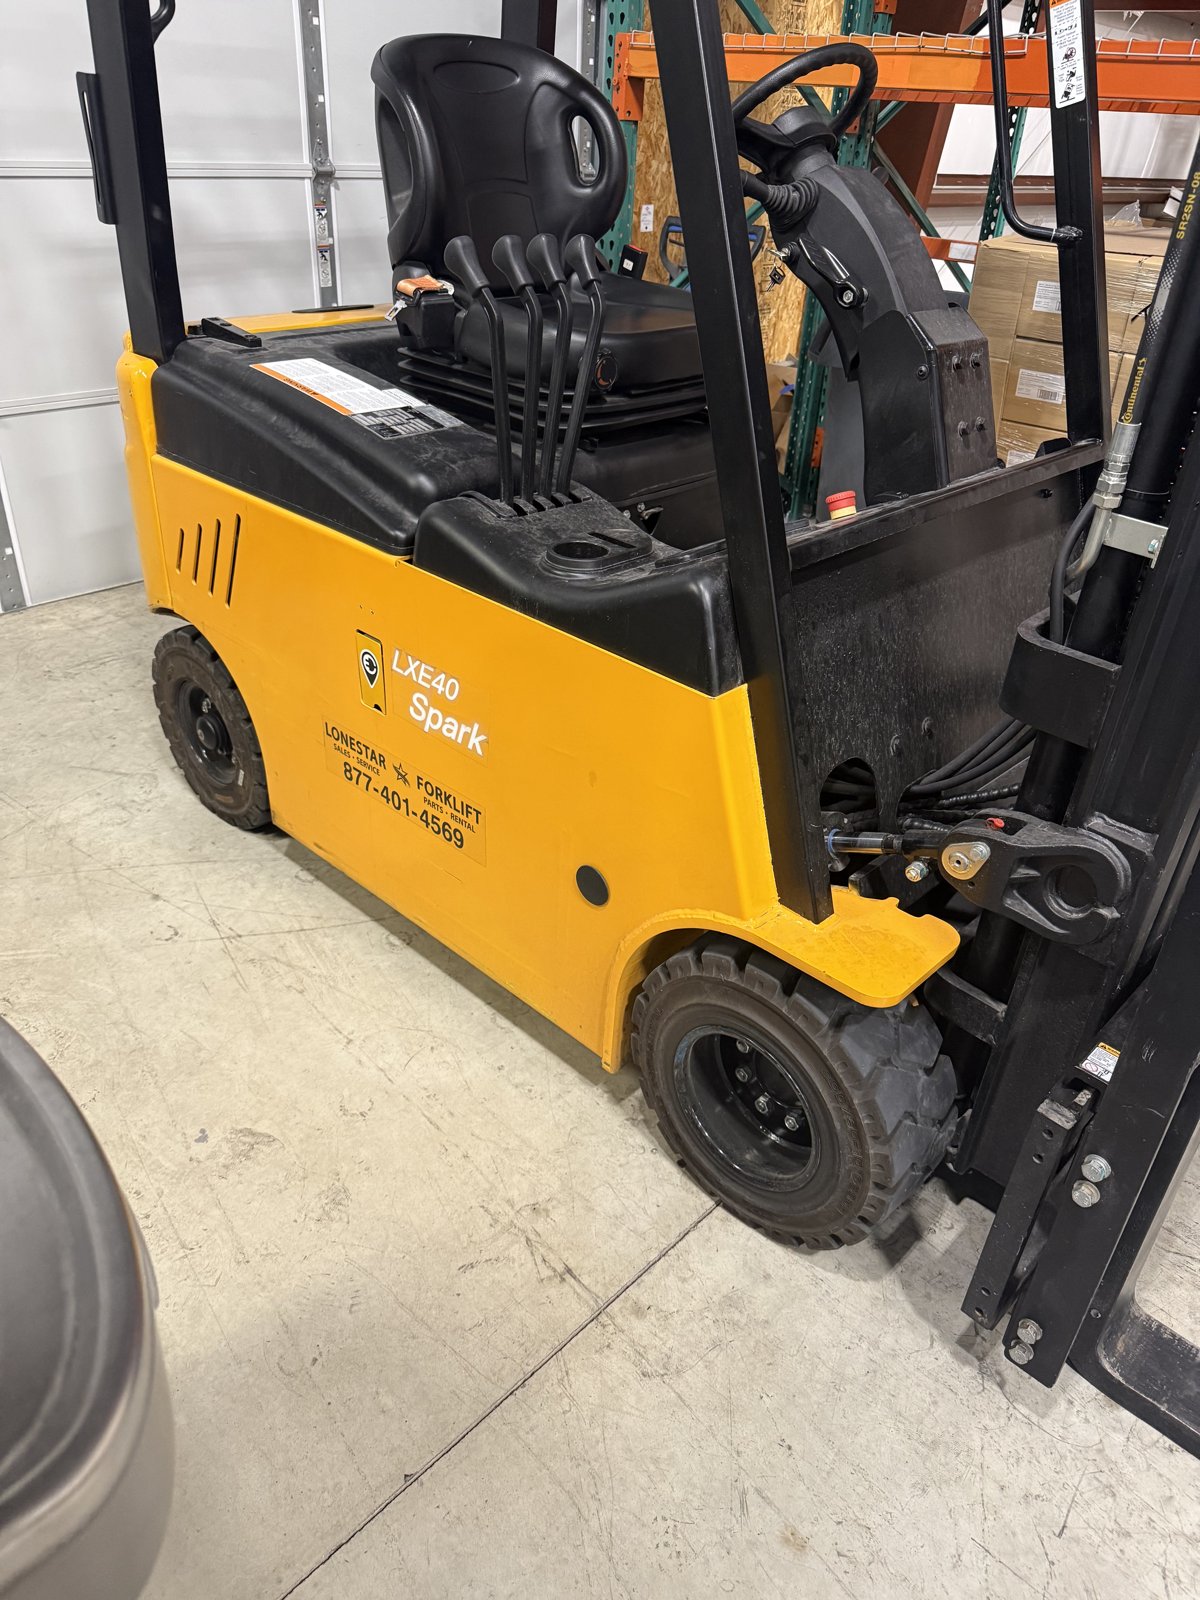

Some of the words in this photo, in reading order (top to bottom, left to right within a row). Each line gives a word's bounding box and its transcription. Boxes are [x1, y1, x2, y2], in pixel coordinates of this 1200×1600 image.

[1121, 366, 1145, 424] Continental
[391, 649, 460, 701] LXE40
[409, 692, 488, 756] Spark
[324, 721, 387, 770] LONESTAR
[416, 775, 482, 825] FORKLIFT
[333, 743, 351, 760] SALES
[356, 756, 381, 777] SERVICE
[423, 796, 444, 815] PARTS
[450, 812, 476, 834] RENTAL
[343, 761, 465, 850] 877-401-4569
